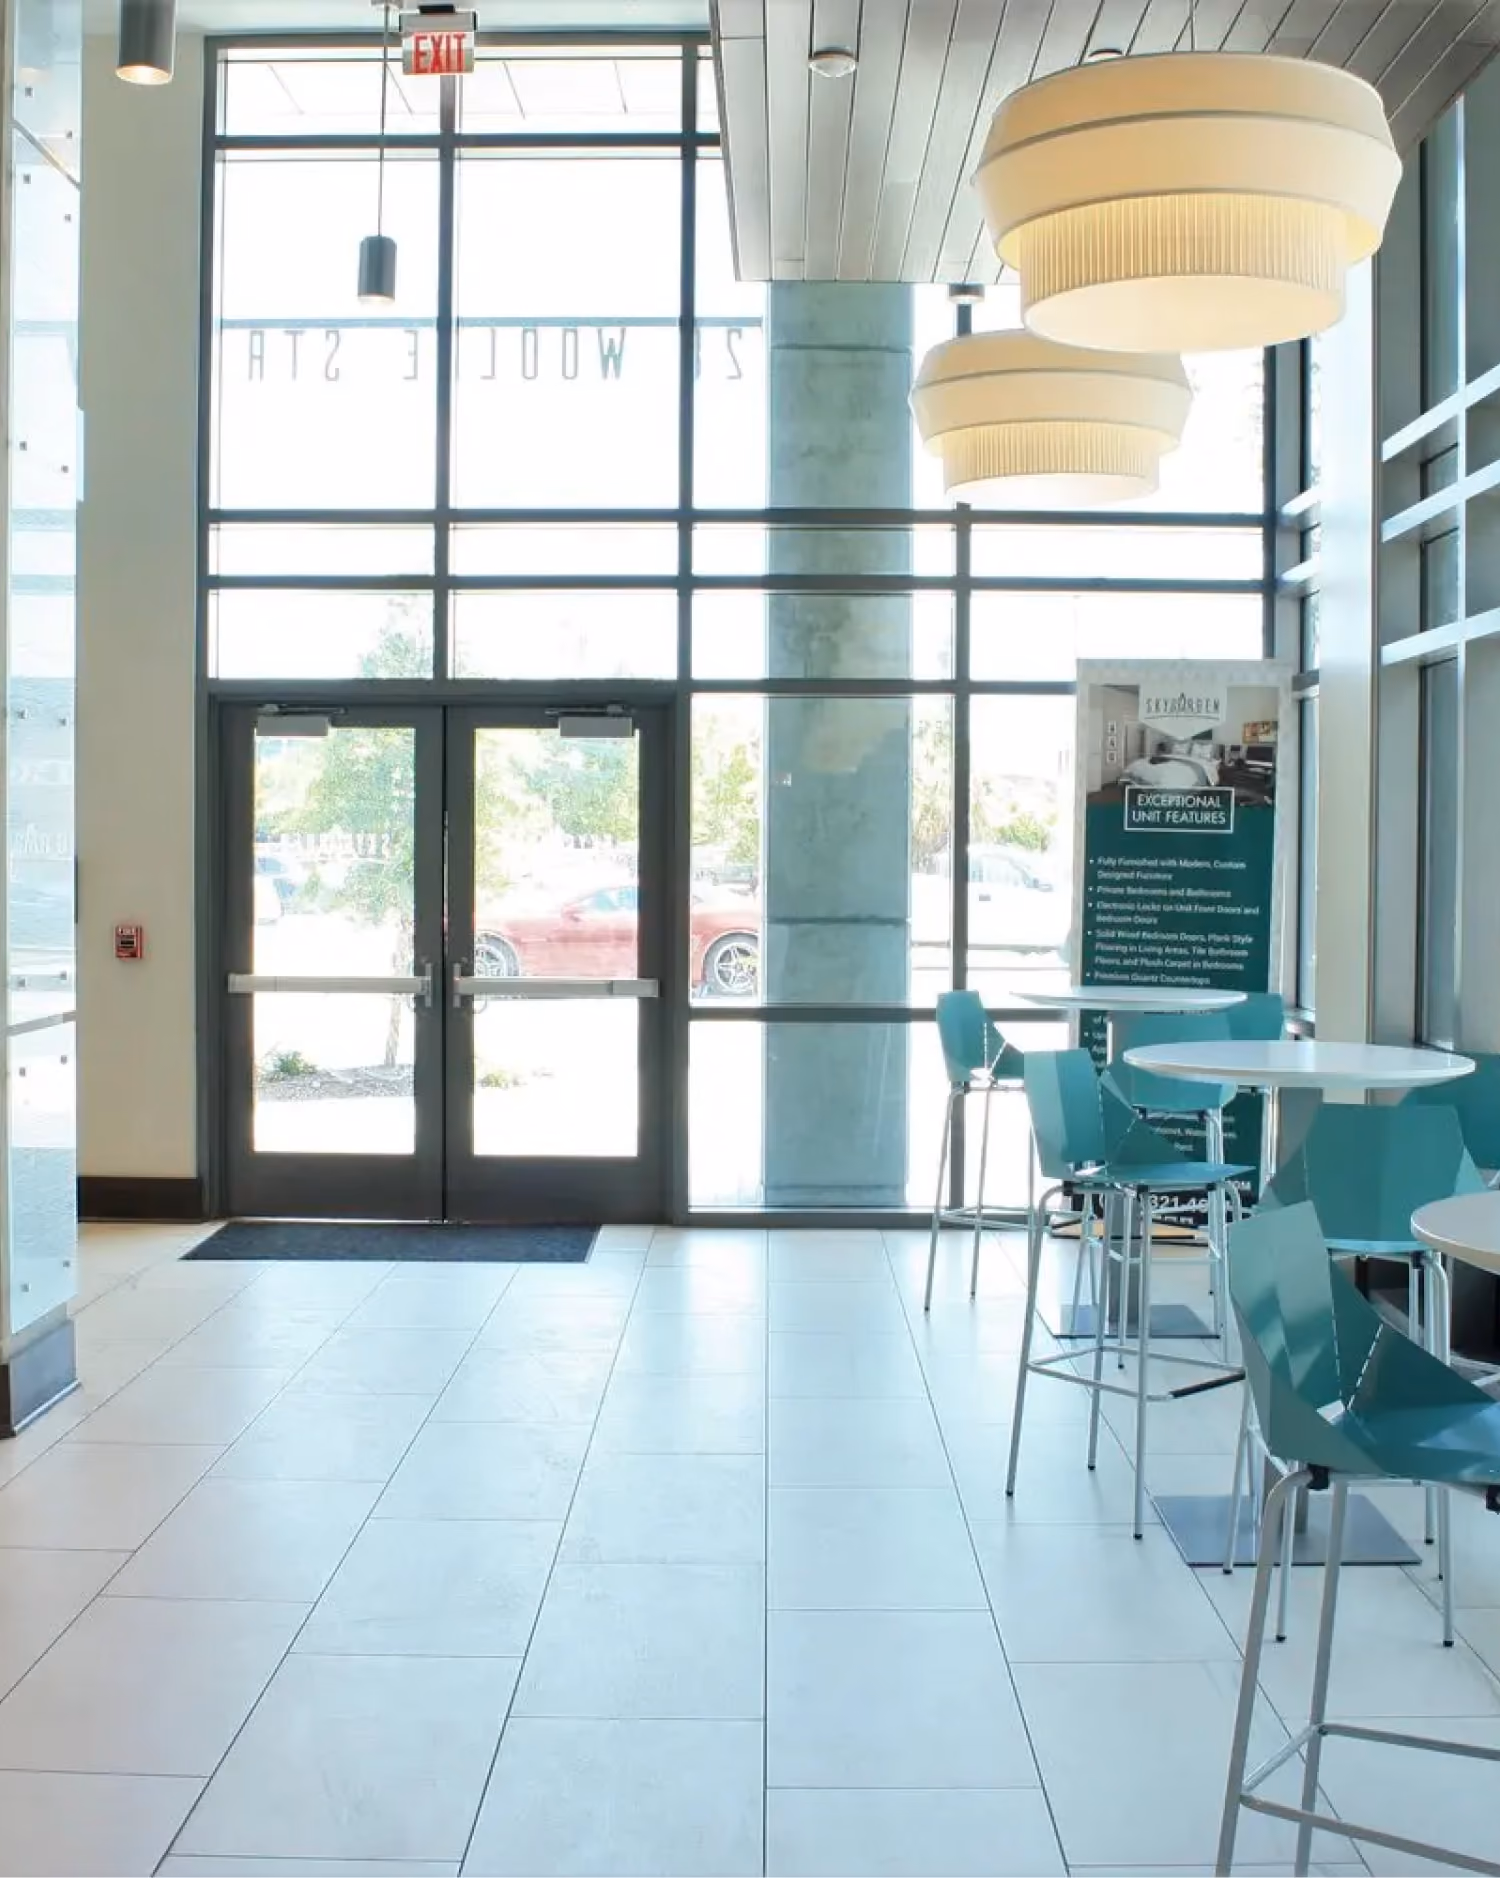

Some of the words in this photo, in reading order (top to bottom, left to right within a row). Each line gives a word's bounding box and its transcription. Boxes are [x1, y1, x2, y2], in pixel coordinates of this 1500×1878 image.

[415, 34, 465, 73] EXIT
[1137, 793, 1222, 808] EXCEPTIONAL
[1132, 811, 1162, 823] UNIT
[1165, 812, 1226, 825] FEATURES
